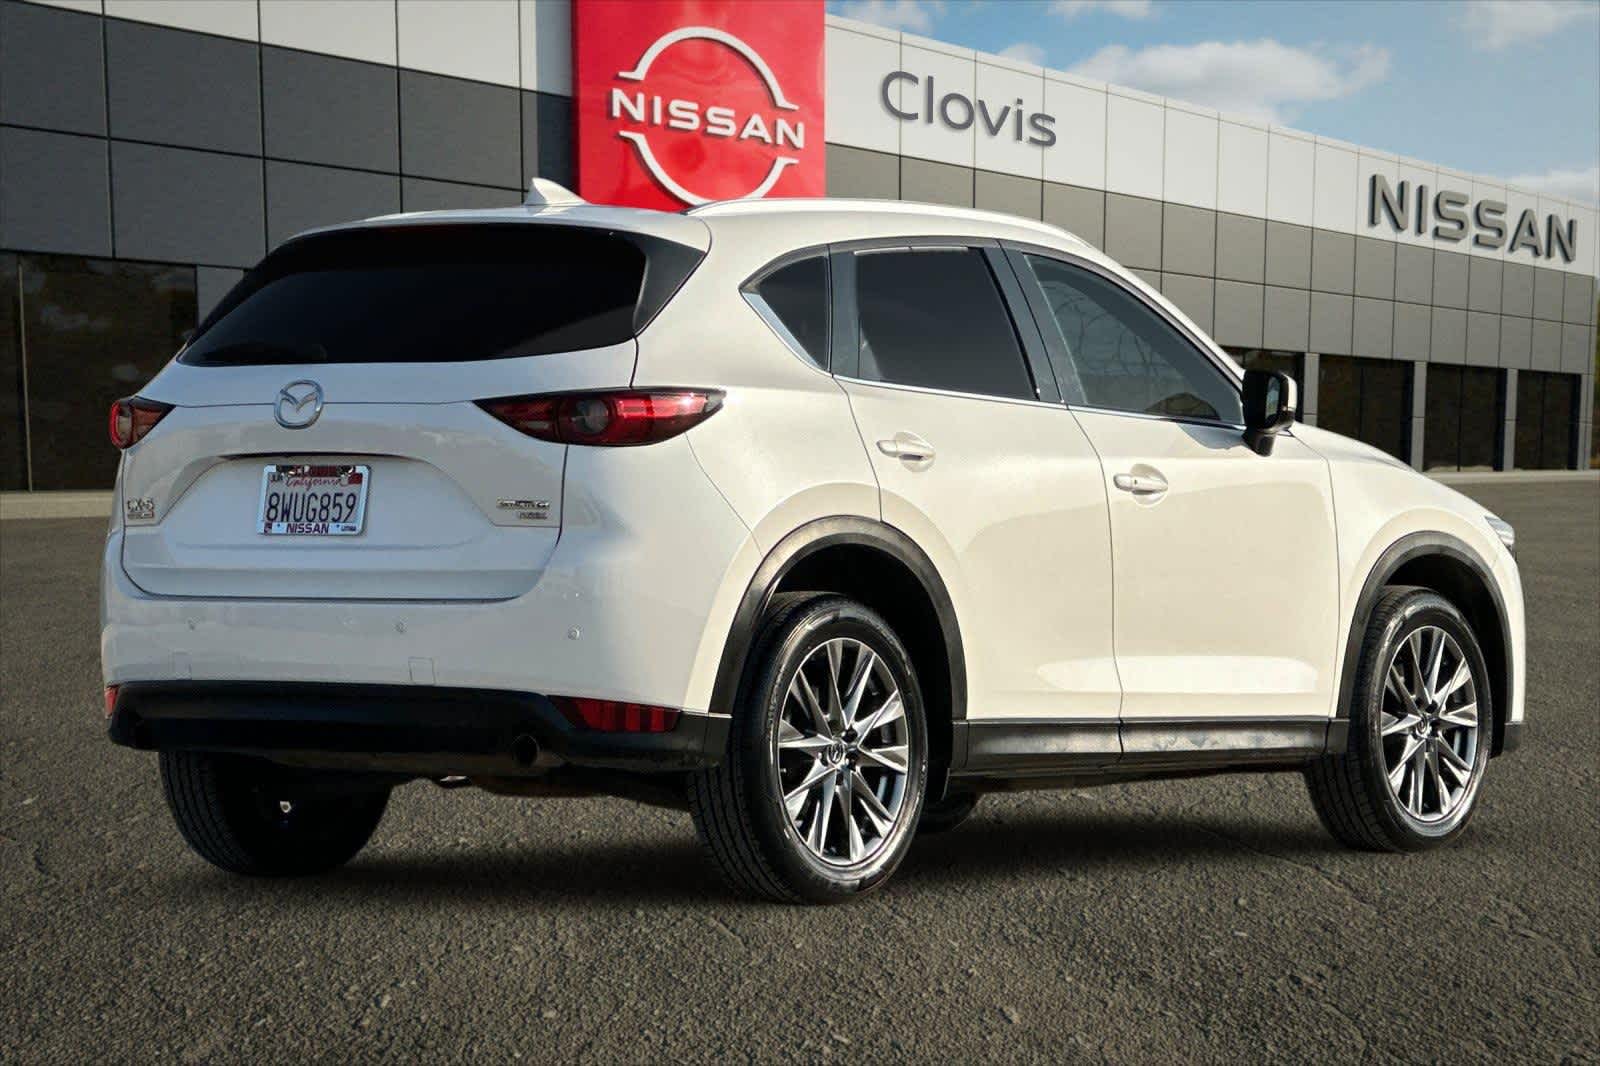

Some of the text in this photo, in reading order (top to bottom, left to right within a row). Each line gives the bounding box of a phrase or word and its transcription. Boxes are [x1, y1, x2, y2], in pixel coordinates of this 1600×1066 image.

[610, 87, 806, 149] NISSAN
[880, 70, 1058, 148] Clovis
[1368, 173, 1578, 263] NISSAN
[266, 492, 357, 523] 8WUG859
[286, 522, 330, 534] NISSAN
